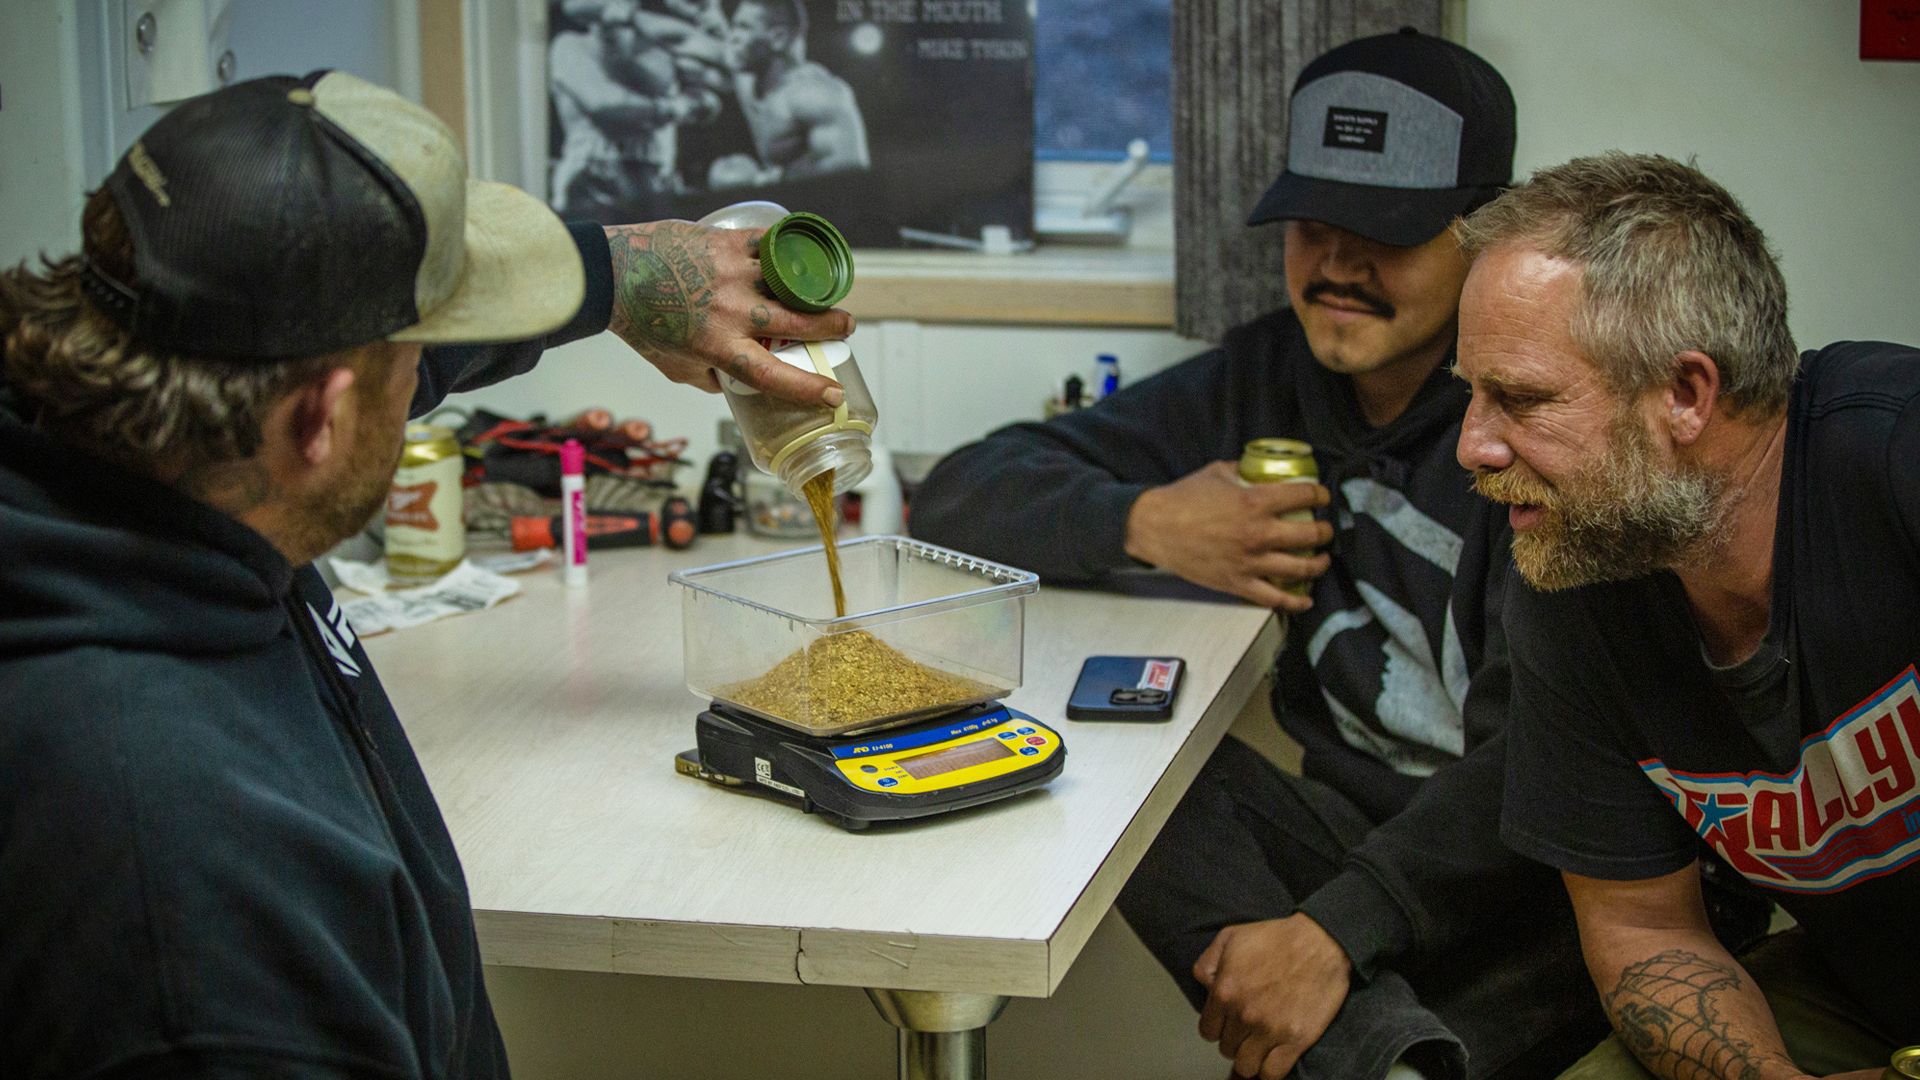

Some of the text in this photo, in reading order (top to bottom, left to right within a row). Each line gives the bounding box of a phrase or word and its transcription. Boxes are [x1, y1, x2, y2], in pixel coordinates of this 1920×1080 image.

[835, 0, 1003, 23] IN THE MOUTH
